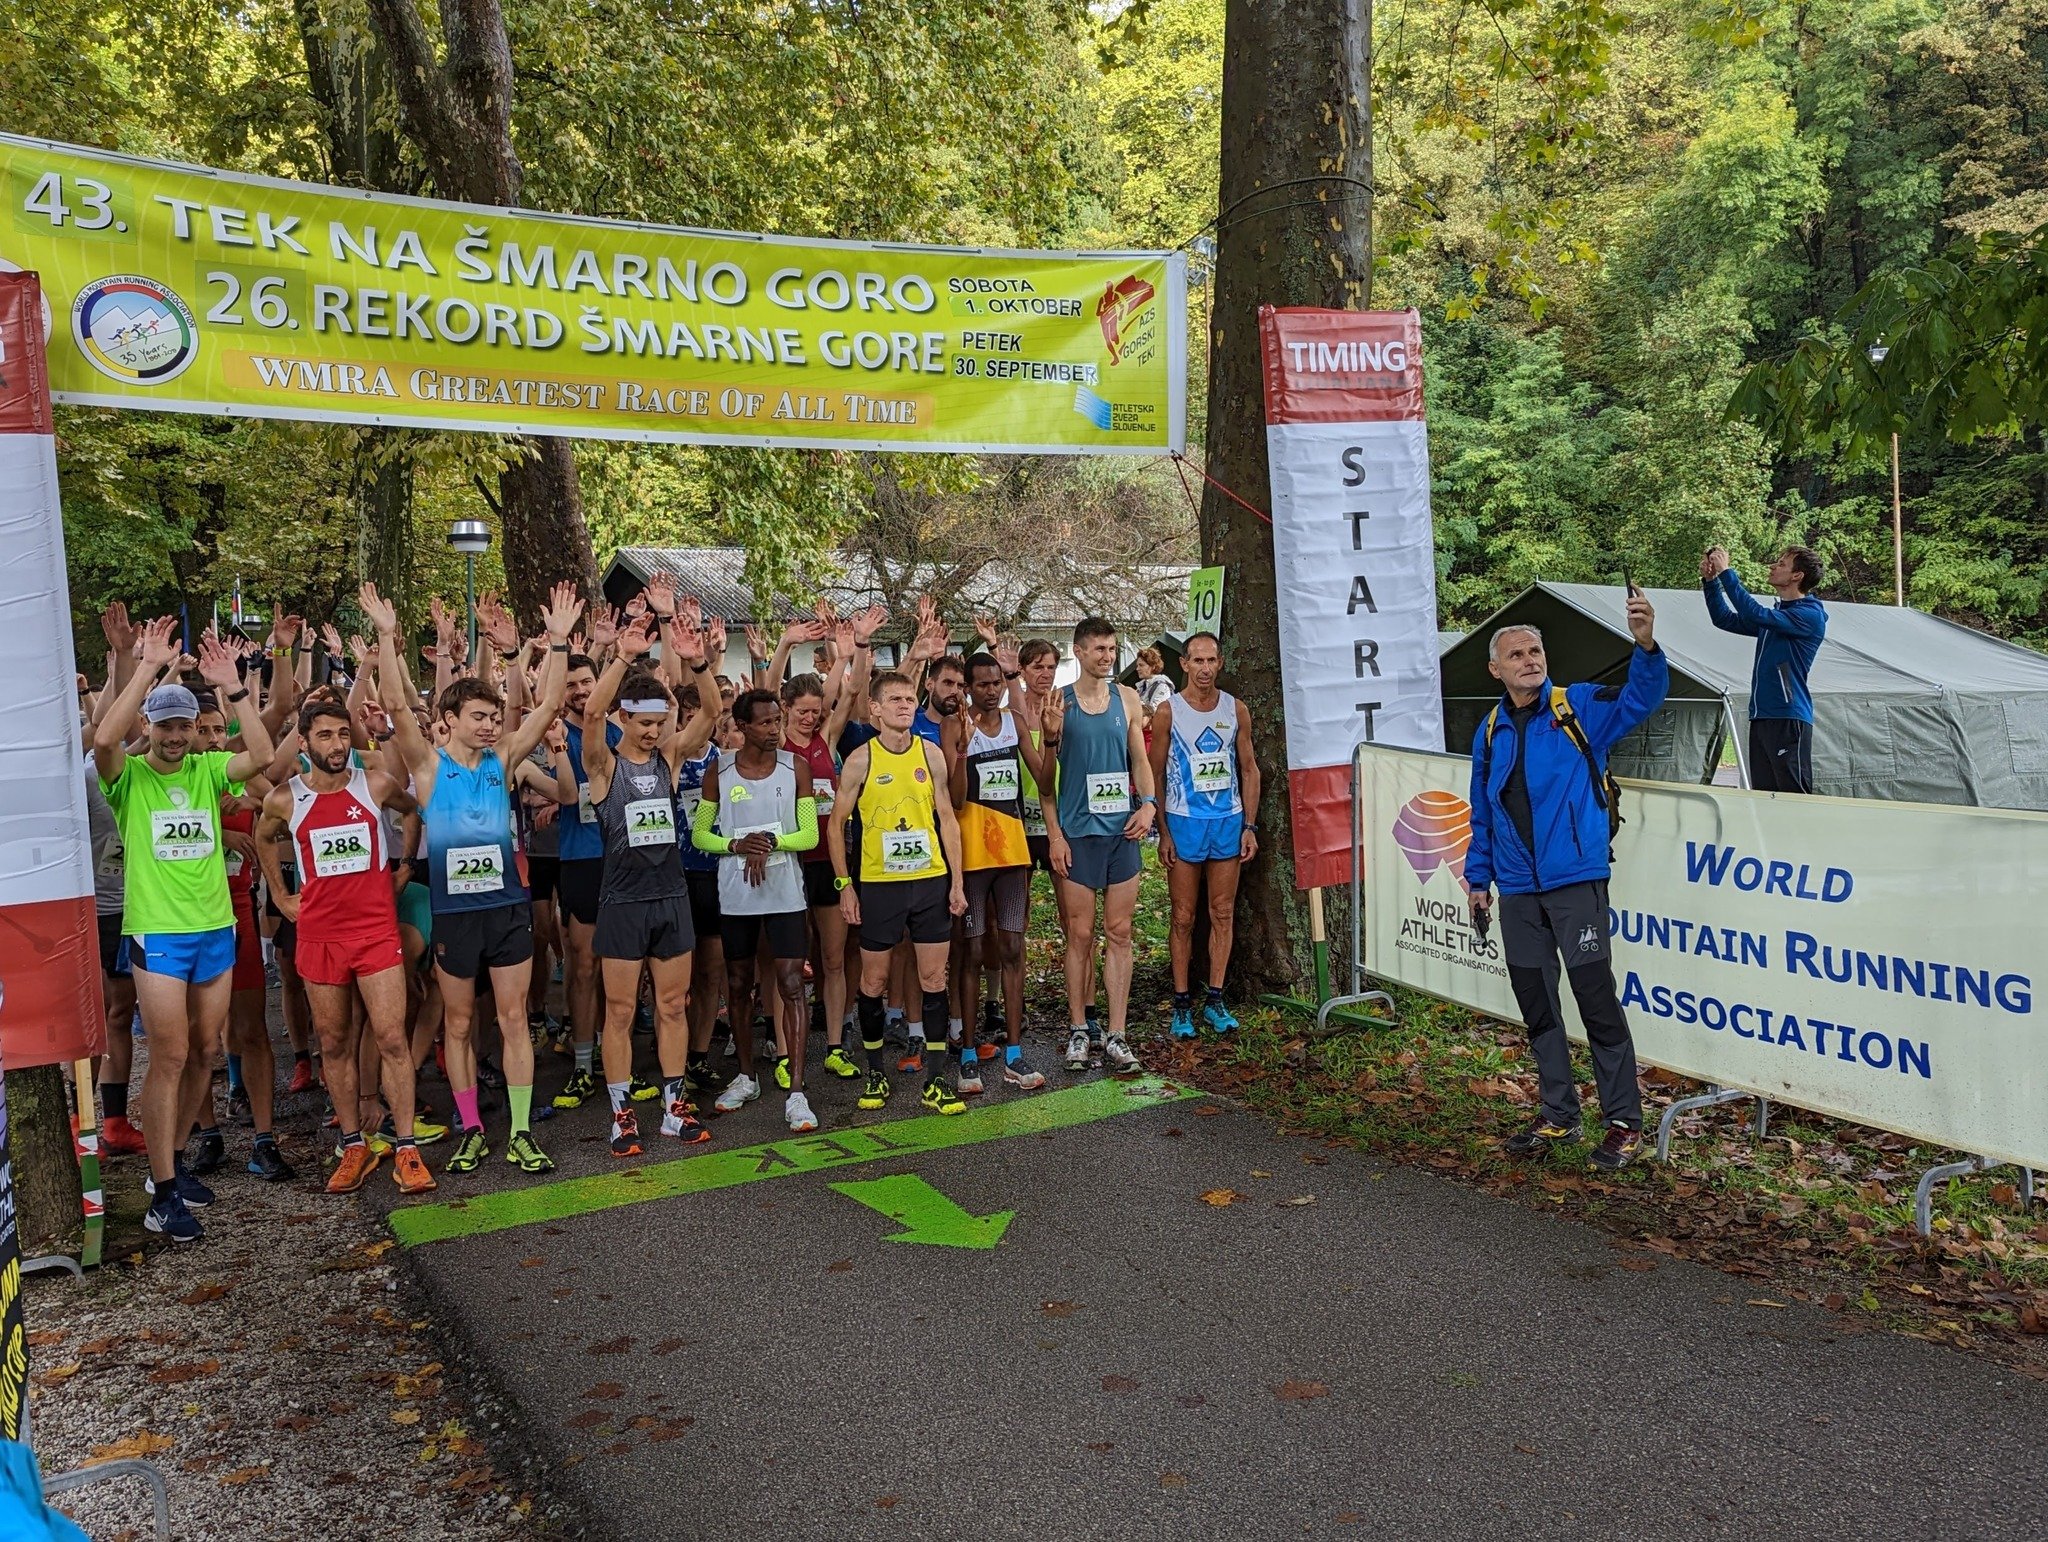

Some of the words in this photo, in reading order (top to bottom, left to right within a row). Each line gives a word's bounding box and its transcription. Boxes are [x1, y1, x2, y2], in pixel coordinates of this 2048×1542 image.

[24, 172, 128, 232] 43.
[154, 194, 309, 254] TEK
[329, 221, 437, 275] NA
[454, 224, 747, 304] ŠMARNO
[766, 268, 935, 312] GORO
[949, 277, 1034, 294] SOBOTA
[74, 291, 89, 313] WORLD
[87, 276, 124, 293] MOUNTAIN
[123, 276, 159, 291] RUNNING
[159, 287, 195, 328] ASSOCIATION
[965, 299, 983, 313] 1.
[988, 299, 1082, 317] OKTOBER
[206, 271, 299, 330] 26.
[313, 284, 563, 348] REKORD
[578, 305, 806, 364] ŠMARNE
[818, 330, 945, 373] GORE
[1139, 307, 1156, 329] AZS
[962, 331, 1022, 351] PETEK
[1123, 326, 1156, 358] GORSKI
[120, 351, 137, 366] 35
[1137, 346, 1156, 367] TEKI
[1287, 341, 1407, 373] TIMING
[249, 356, 400, 397] WMRA
[955, 357, 980, 377] 30.
[986, 360, 1098, 384] SEPTEMBER
[1112, 404, 1155, 413] ATLETSKA
[1112, 423, 1156, 432] SLOVENIJE
[1341, 446, 1382, 741] START
[1193, 589, 1216, 621] 10
[987, 769, 1013, 785] 279
[1199, 761, 1224, 776] 272
[1096, 782, 1122, 797] 223
[635, 810, 668, 827] 213
[1024, 806, 1042, 820] 25
[164, 822, 202, 839] 207
[322, 836, 361, 856] 288
[892, 841, 923, 857] 255
[457, 857, 493, 875] 229
[1686, 841, 1854, 903] WORLD
[1395, 940, 1440, 959] ASSOCIATED
[1442, 952, 1507, 977] ORGANISATIONS
[1606, 906, 1767, 969] OUNTAIN
[1786, 930, 2032, 1014] RUNNING
[1621, 971, 1931, 1079] ASSOCIATION
